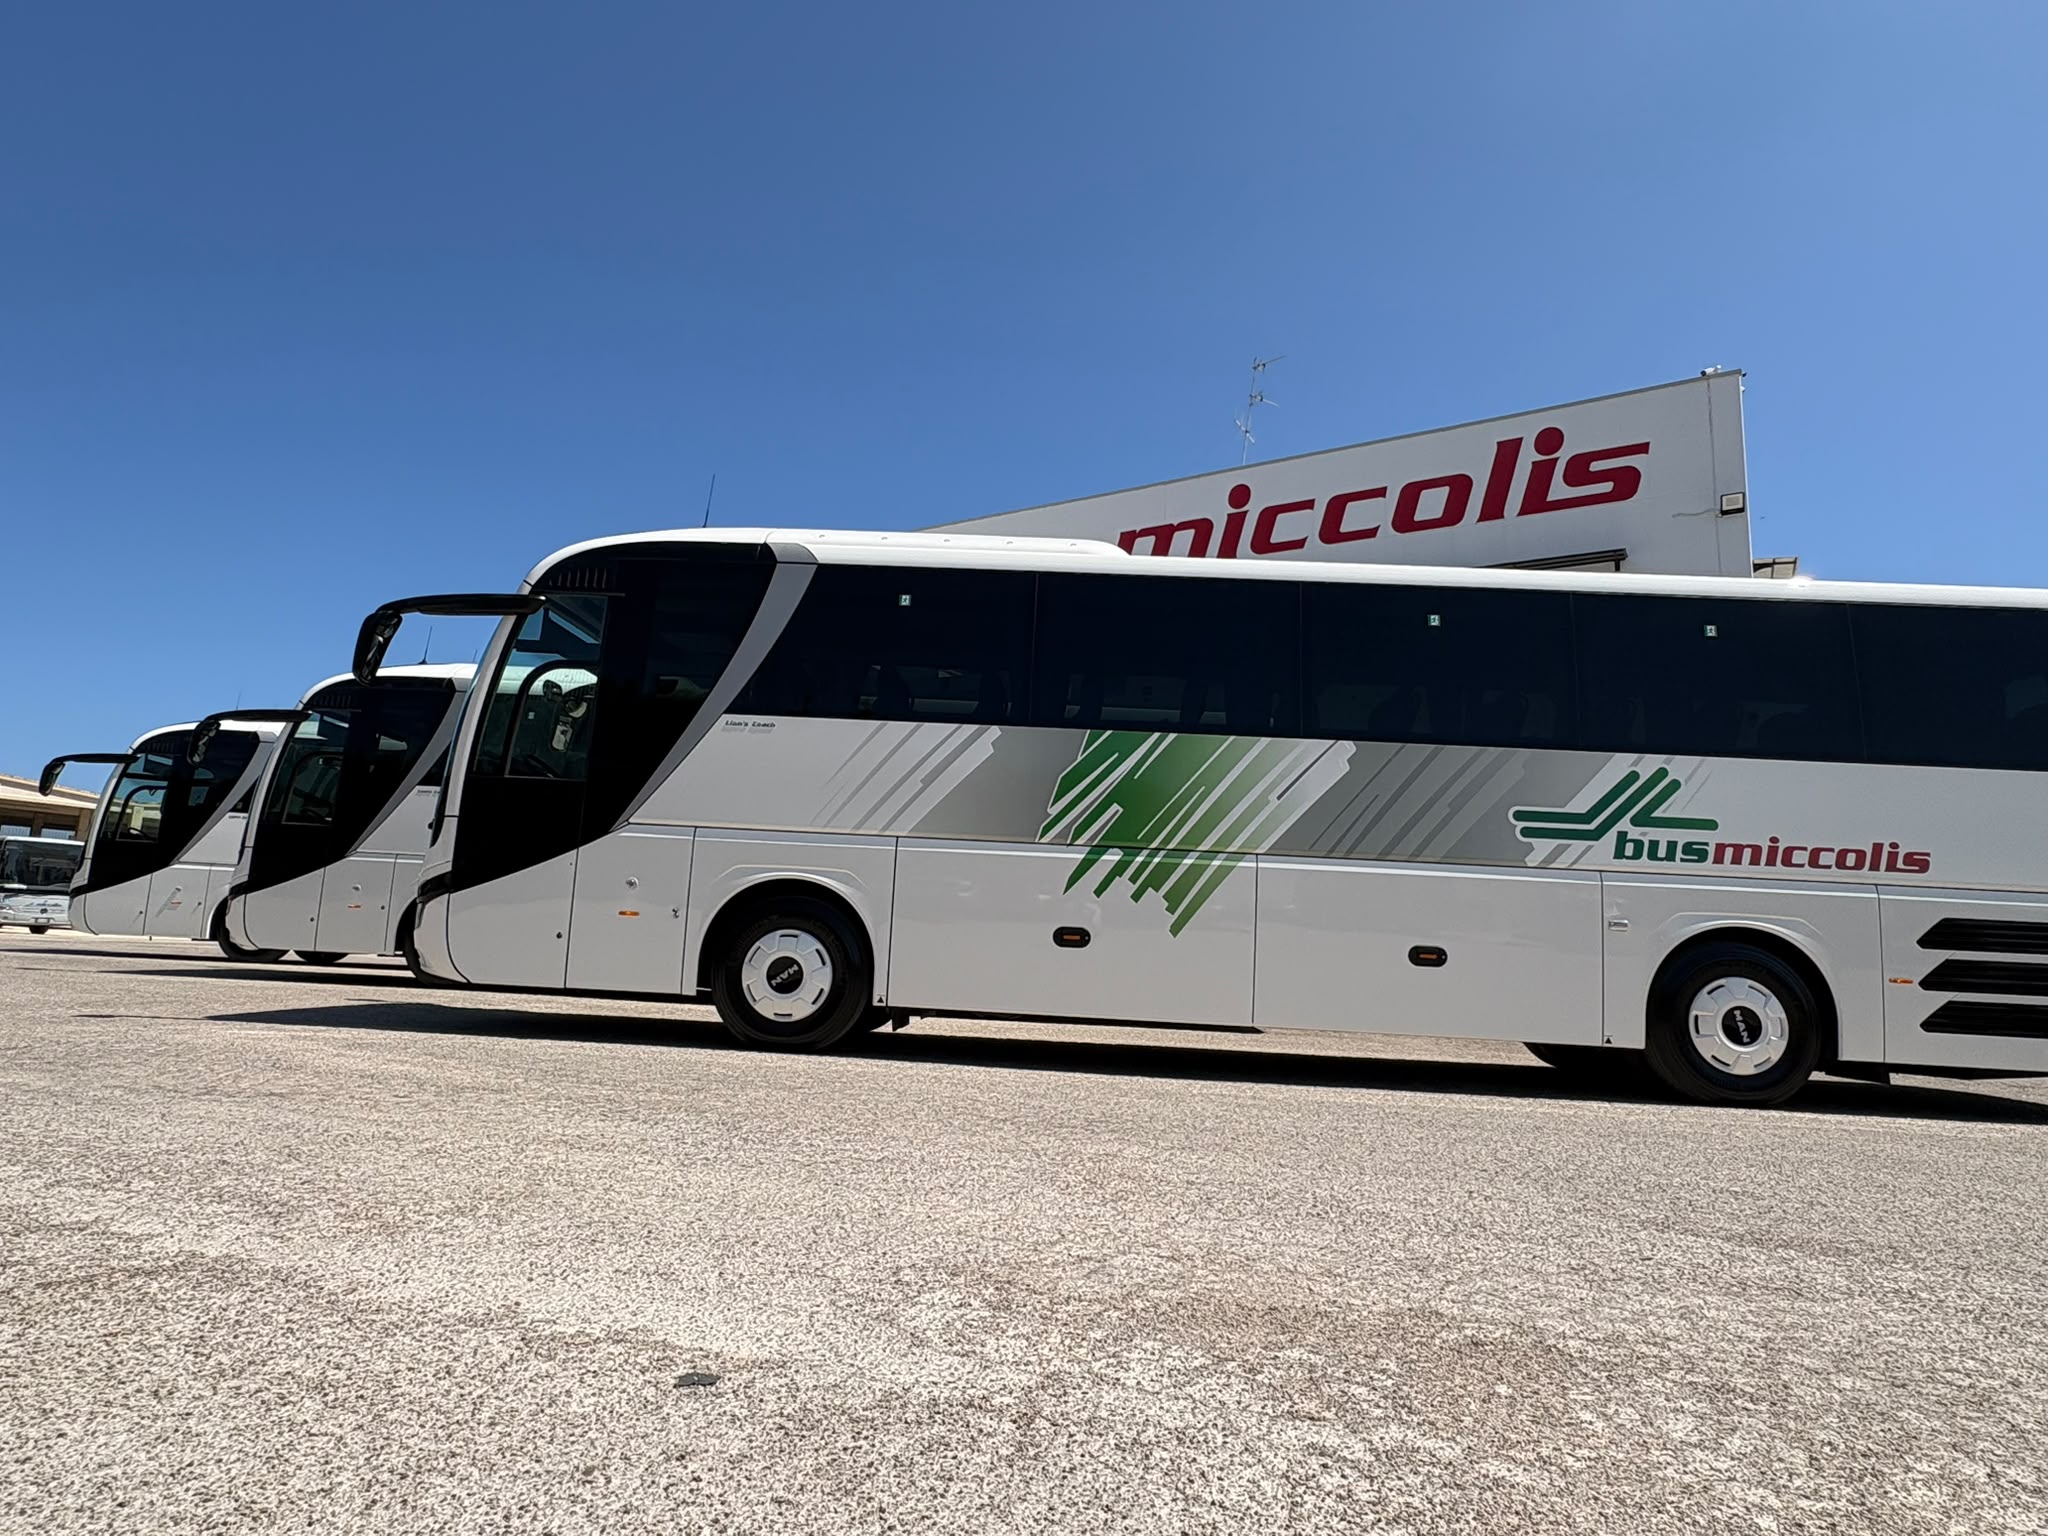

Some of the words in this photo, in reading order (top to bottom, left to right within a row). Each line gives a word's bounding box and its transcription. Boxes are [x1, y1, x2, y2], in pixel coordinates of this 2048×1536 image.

[1118, 425, 1651, 559] miccolis
[725, 719, 749, 728] Lion's
[751, 720, 776, 729] Coach
[770, 963, 800, 988] MAN
[1733, 1009, 1751, 1044] MAN
